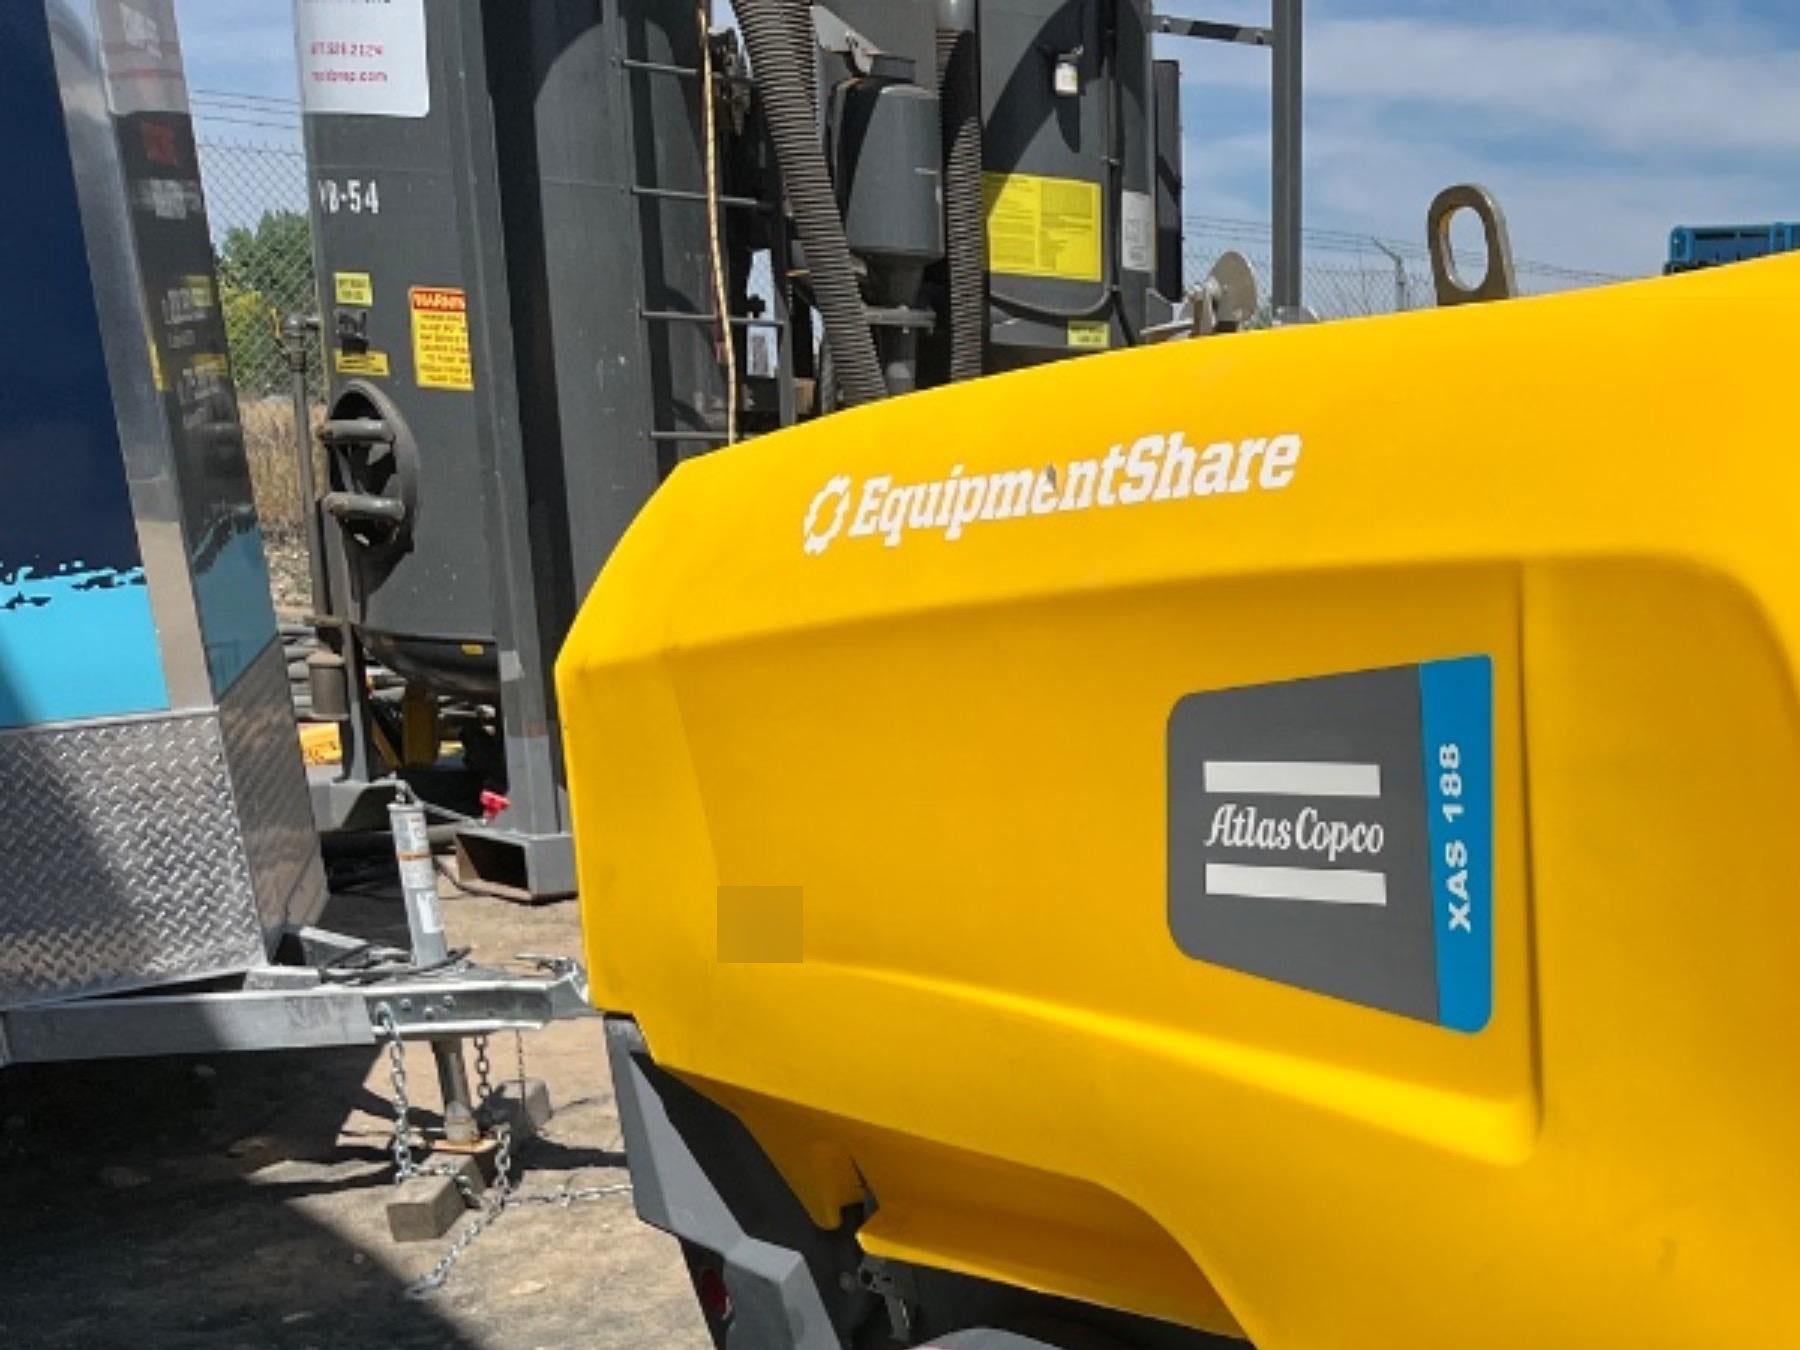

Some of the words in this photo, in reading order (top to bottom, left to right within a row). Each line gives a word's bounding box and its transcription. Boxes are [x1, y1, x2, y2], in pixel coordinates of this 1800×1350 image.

[848, 431, 1302, 547] EquipmentShare
[1438, 742, 1465, 824] 188
[1203, 803, 1292, 851] Atlas
[1295, 805, 1385, 862] Copco
[1445, 839, 1472, 933] XAS
